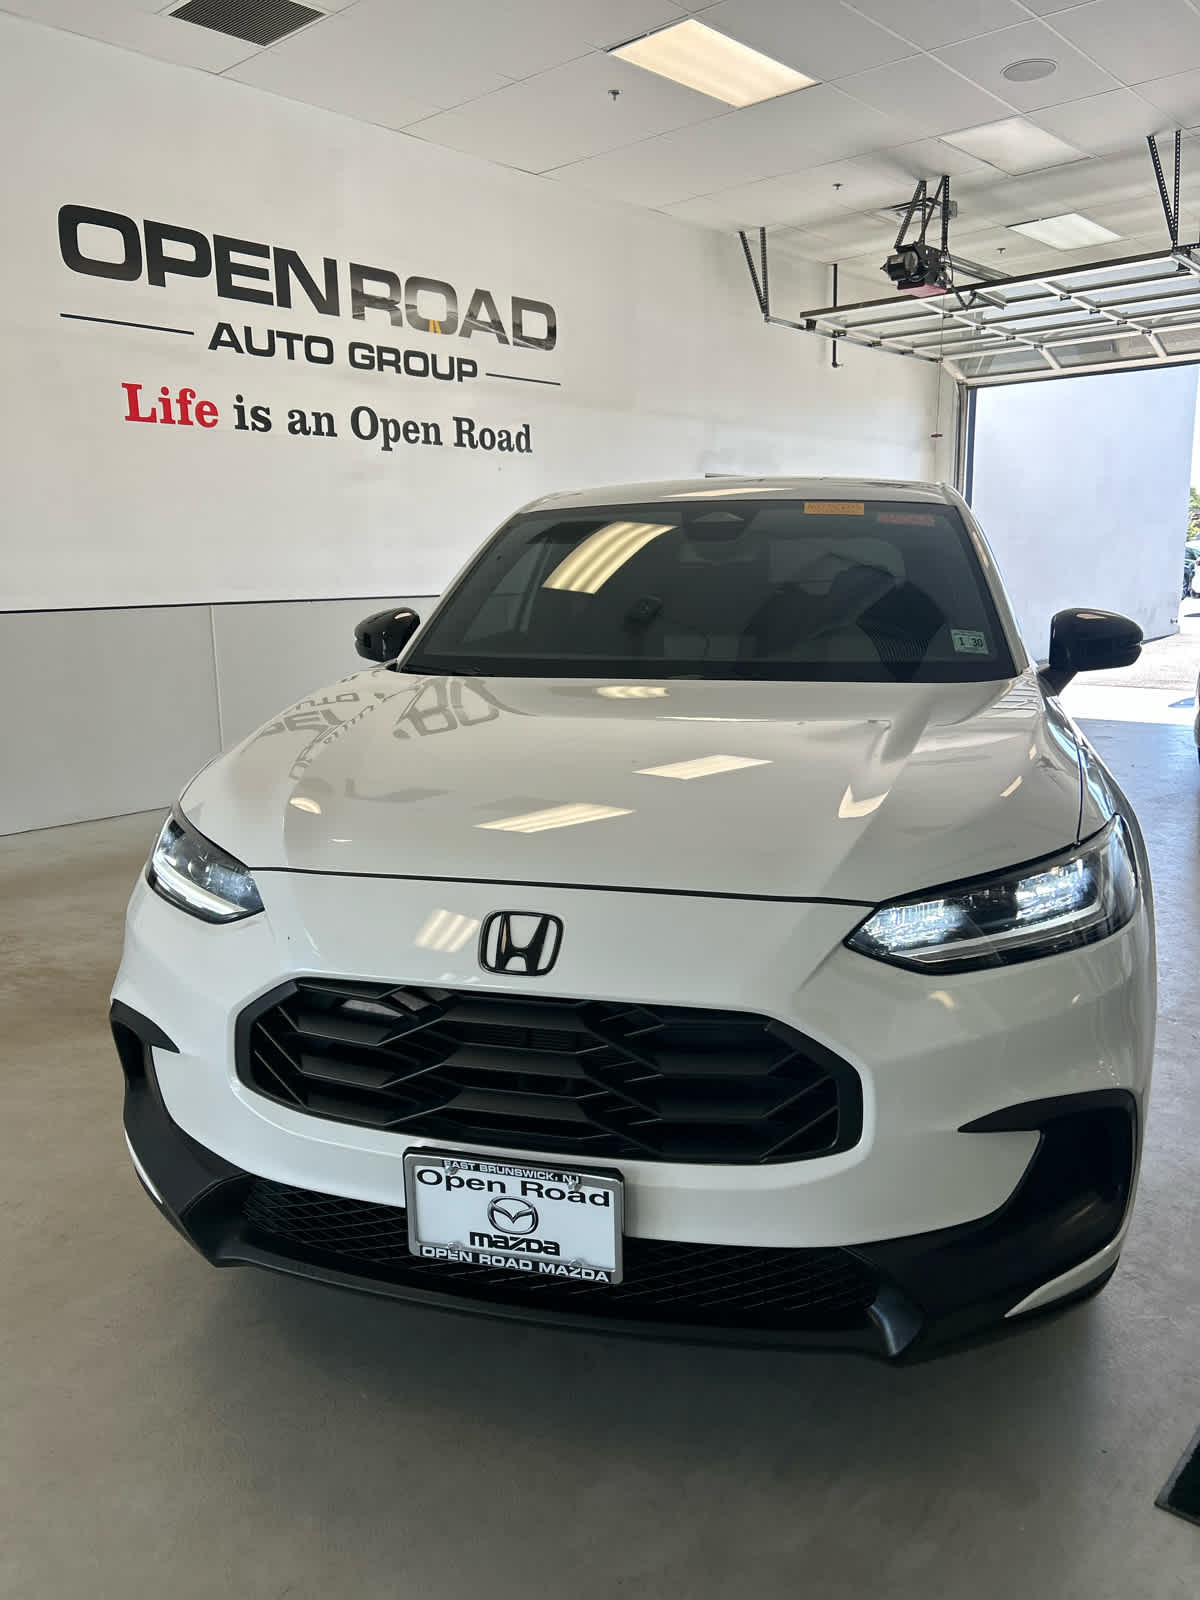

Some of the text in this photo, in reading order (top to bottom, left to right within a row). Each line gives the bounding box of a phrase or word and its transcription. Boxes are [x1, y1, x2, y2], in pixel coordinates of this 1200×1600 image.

[208, 322, 478, 383] AUTO GROUP
[121, 382, 533, 454] Life is an Open Road
[416, 1168, 610, 1208] Open Road
[443, 1159, 475, 1170] EAST
[562, 1174, 581, 1185] NJ
[422, 1246, 610, 1283] OPEN ROAD MAZDA
